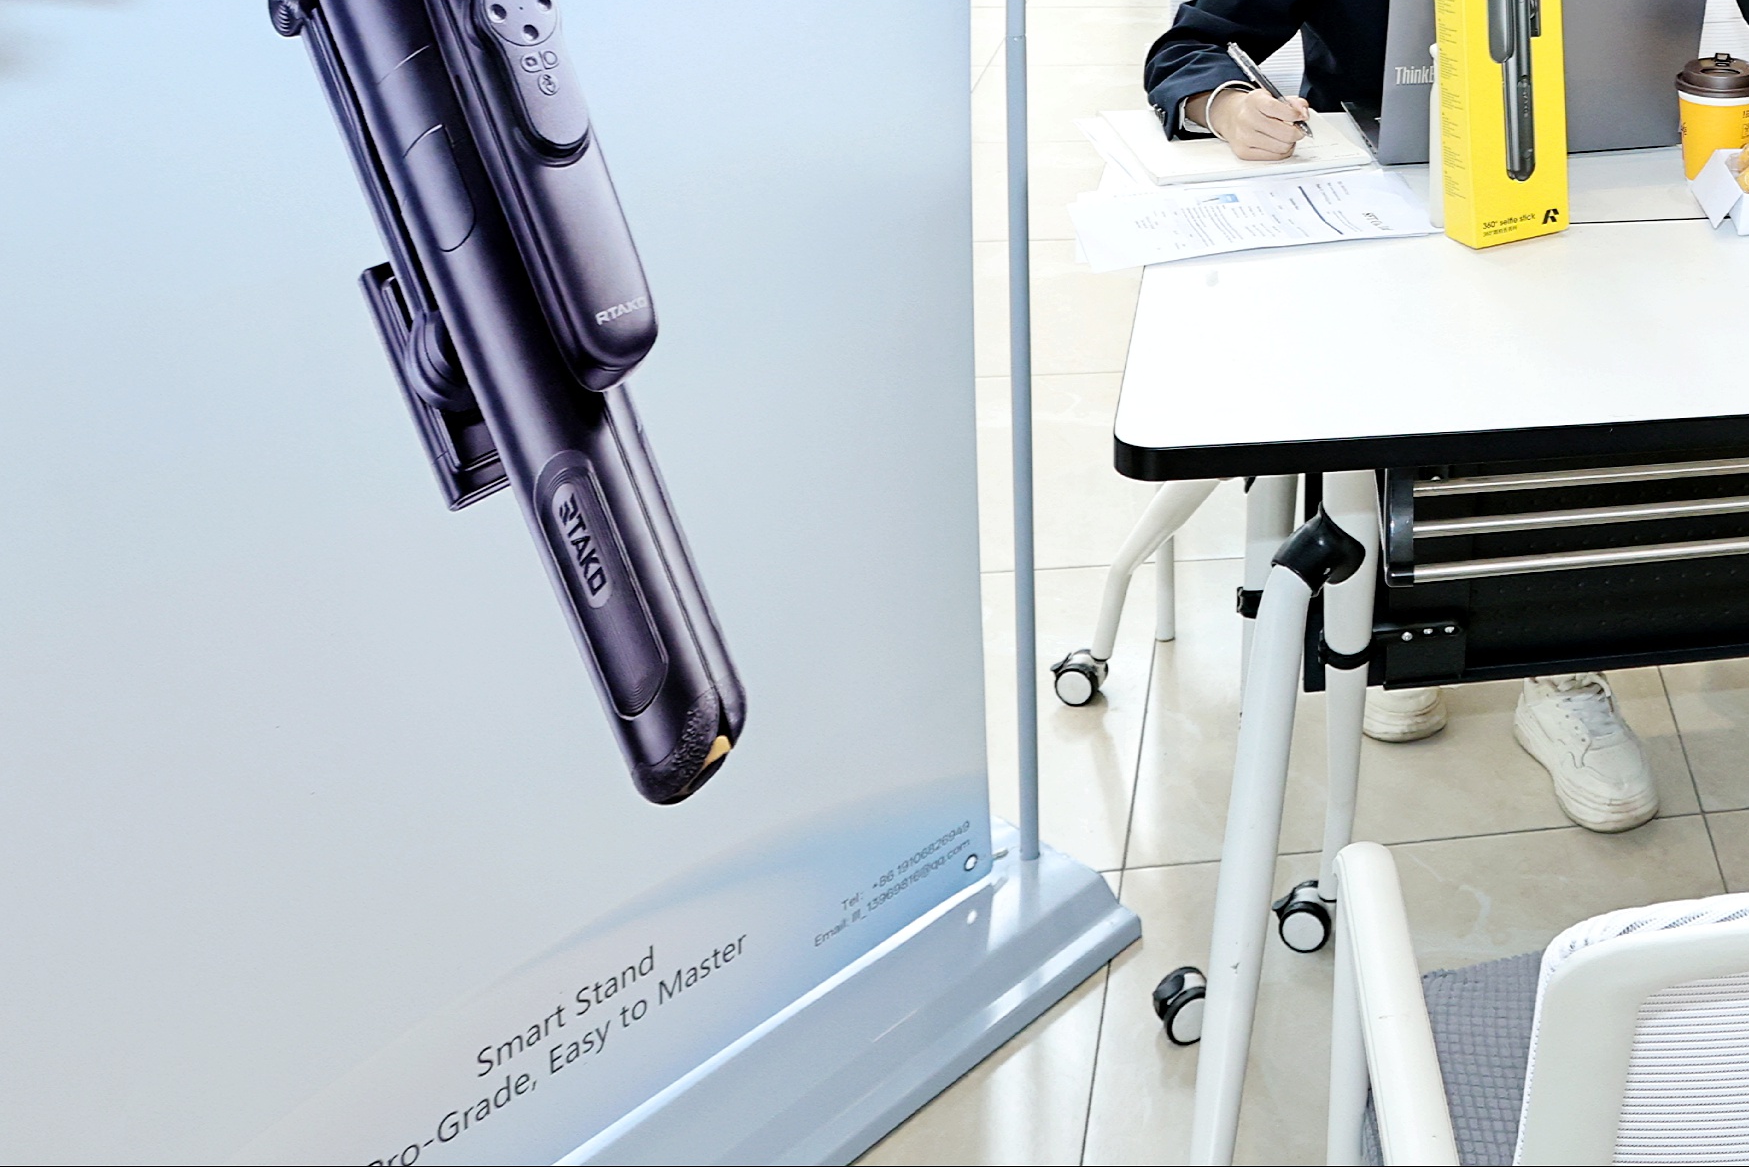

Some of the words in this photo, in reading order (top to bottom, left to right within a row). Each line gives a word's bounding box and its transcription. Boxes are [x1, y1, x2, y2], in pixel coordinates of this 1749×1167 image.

[595, 296, 647, 325] RTAKO
[367, 1073, 538, 1166] ro-Grade,
[549, 1019, 611, 1075] Easy
[620, 998, 648, 1029] to
[658, 934, 747, 1006] Master
[476, 1004, 565, 1078] Smart
[575, 945, 655, 1017] Stand
